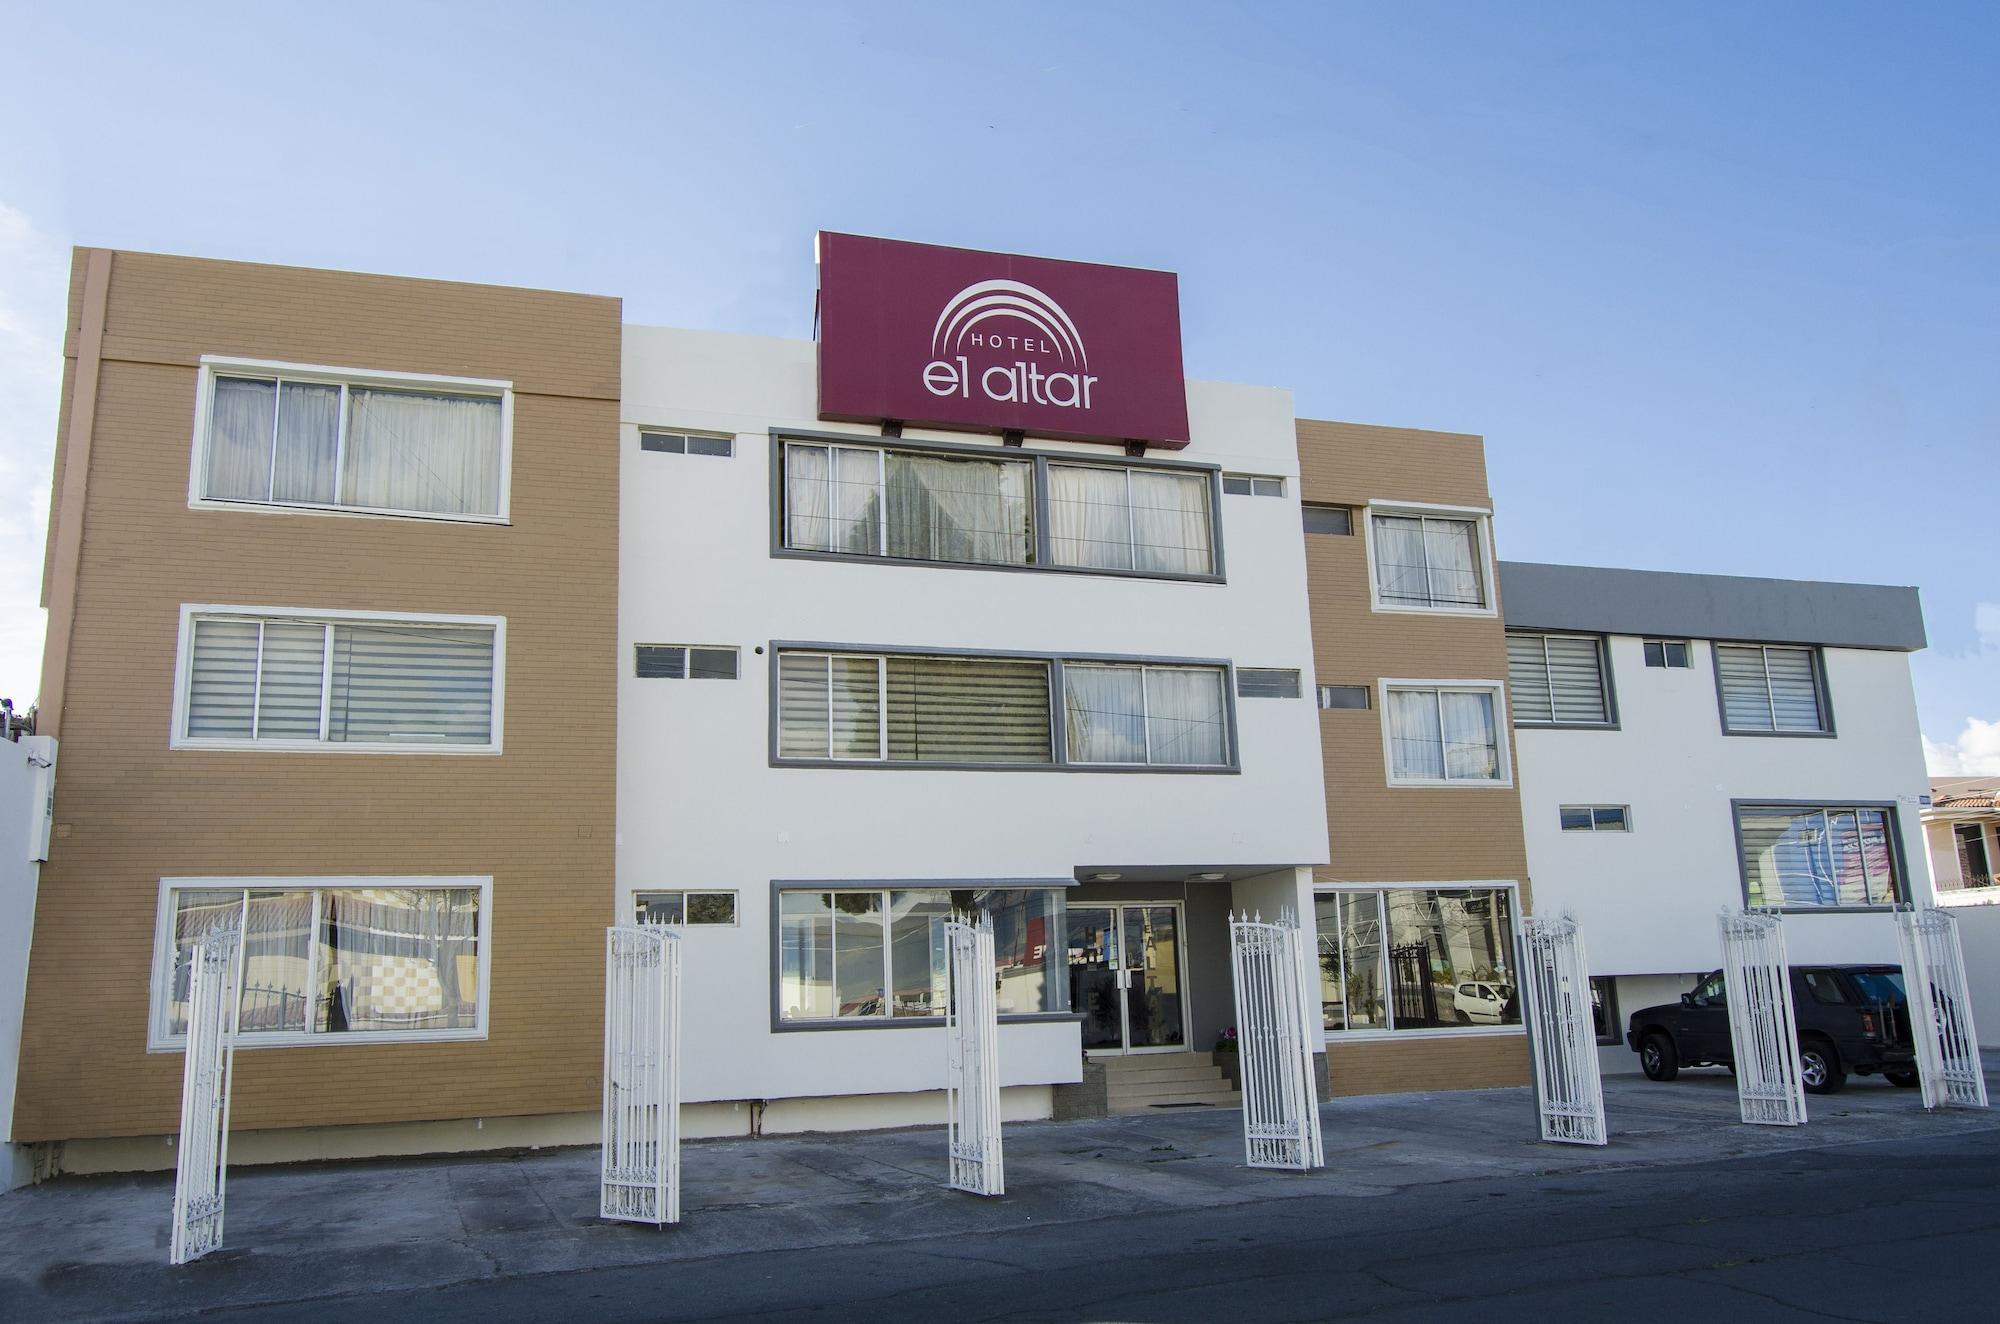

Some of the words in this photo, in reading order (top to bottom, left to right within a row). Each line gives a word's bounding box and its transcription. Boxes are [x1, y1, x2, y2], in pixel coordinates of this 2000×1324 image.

[971, 332, 1050, 353] HOTEL
[922, 355, 969, 398] el
[981, 361, 1098, 409] altar
